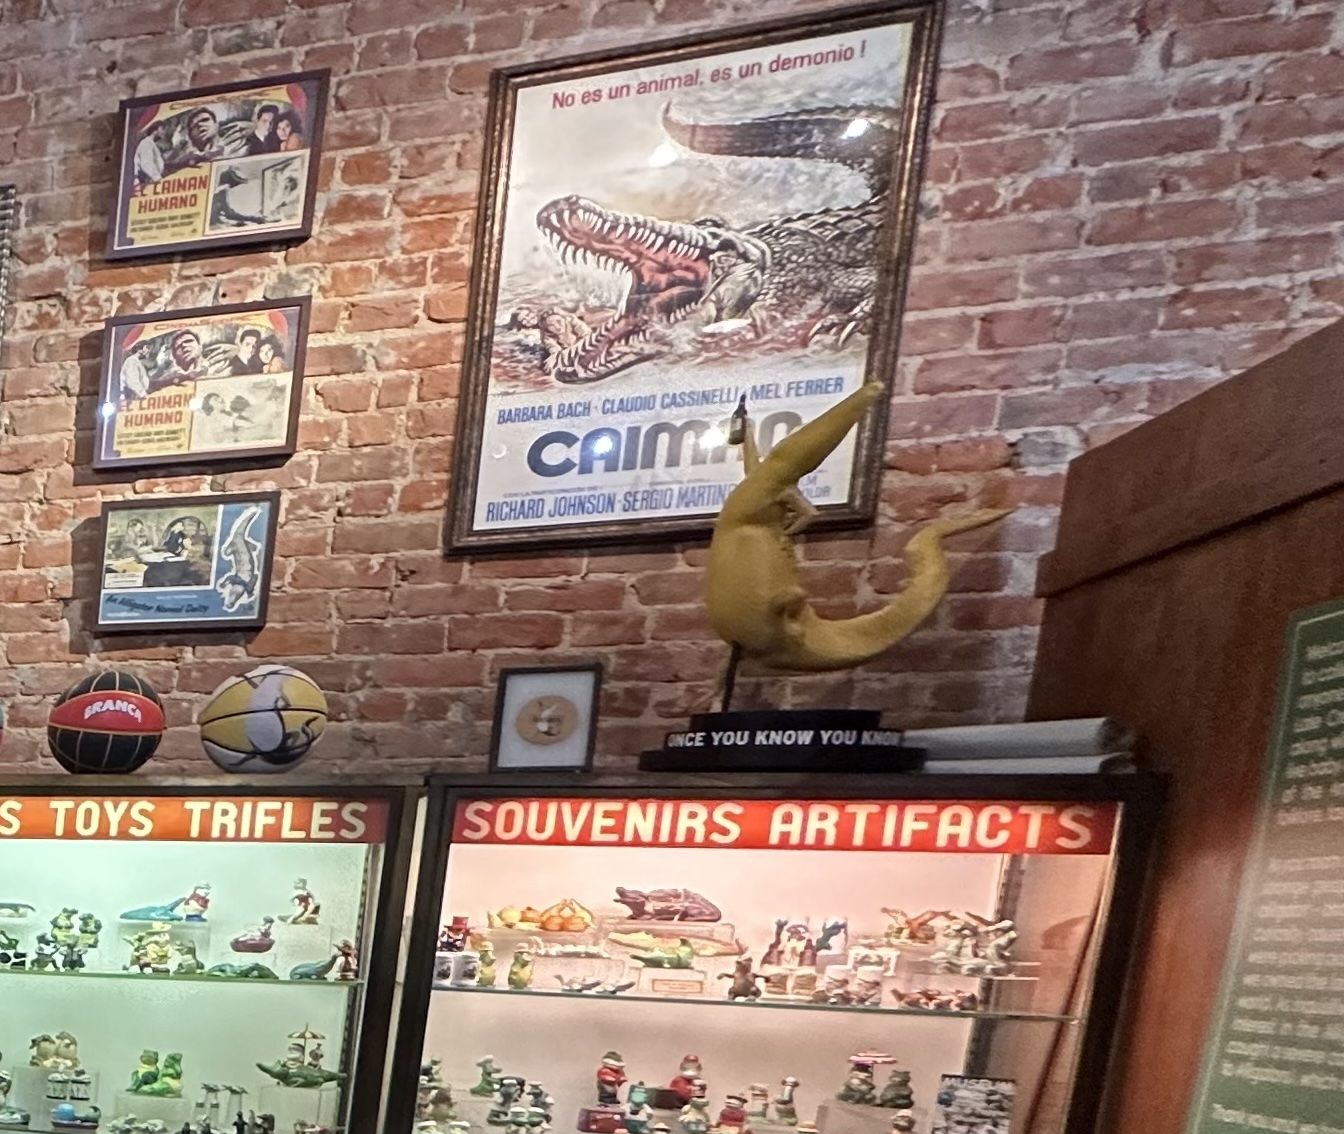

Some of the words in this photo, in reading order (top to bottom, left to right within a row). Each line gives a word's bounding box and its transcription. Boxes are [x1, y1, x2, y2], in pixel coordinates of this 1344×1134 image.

[552, 91, 576, 109] No
[581, 90, 603, 105] es
[608, 84, 631, 100] un
[709, 66, 732, 83] es
[738, 62, 762, 79] un
[768, 46, 855, 73] demonio
[152, 175, 209, 196] CAIMAN
[137, 194, 198, 214] HUMANO
[496, 404, 554, 425] BARBARA
[556, 400, 593, 420] BACH
[601, 393, 656, 416] CLAUDIO
[661, 387, 739, 411] CASSINELLI
[749, 382, 785, 401] MEL
[786, 377, 845, 396] FERRER
[124, 411, 184, 428] HUMANO
[485, 498, 546, 523] RICHARD
[548, 491, 618, 518] JOHNSON
[622, 486, 673, 513] SERGIO
[83, 699, 143, 724] BRANCA
[667, 731, 707, 748] ONCE
[710, 730, 750, 747] YOU
[753, 729, 814, 746] KNOW
[818, 729, 858, 746] YOU
[48, 800, 158, 838] TOYS
[175, 801, 369, 841] TRIFLES
[461, 800, 745, 846] SOUVENIRS
[767, 803, 1095, 850] ARTIFACTS
